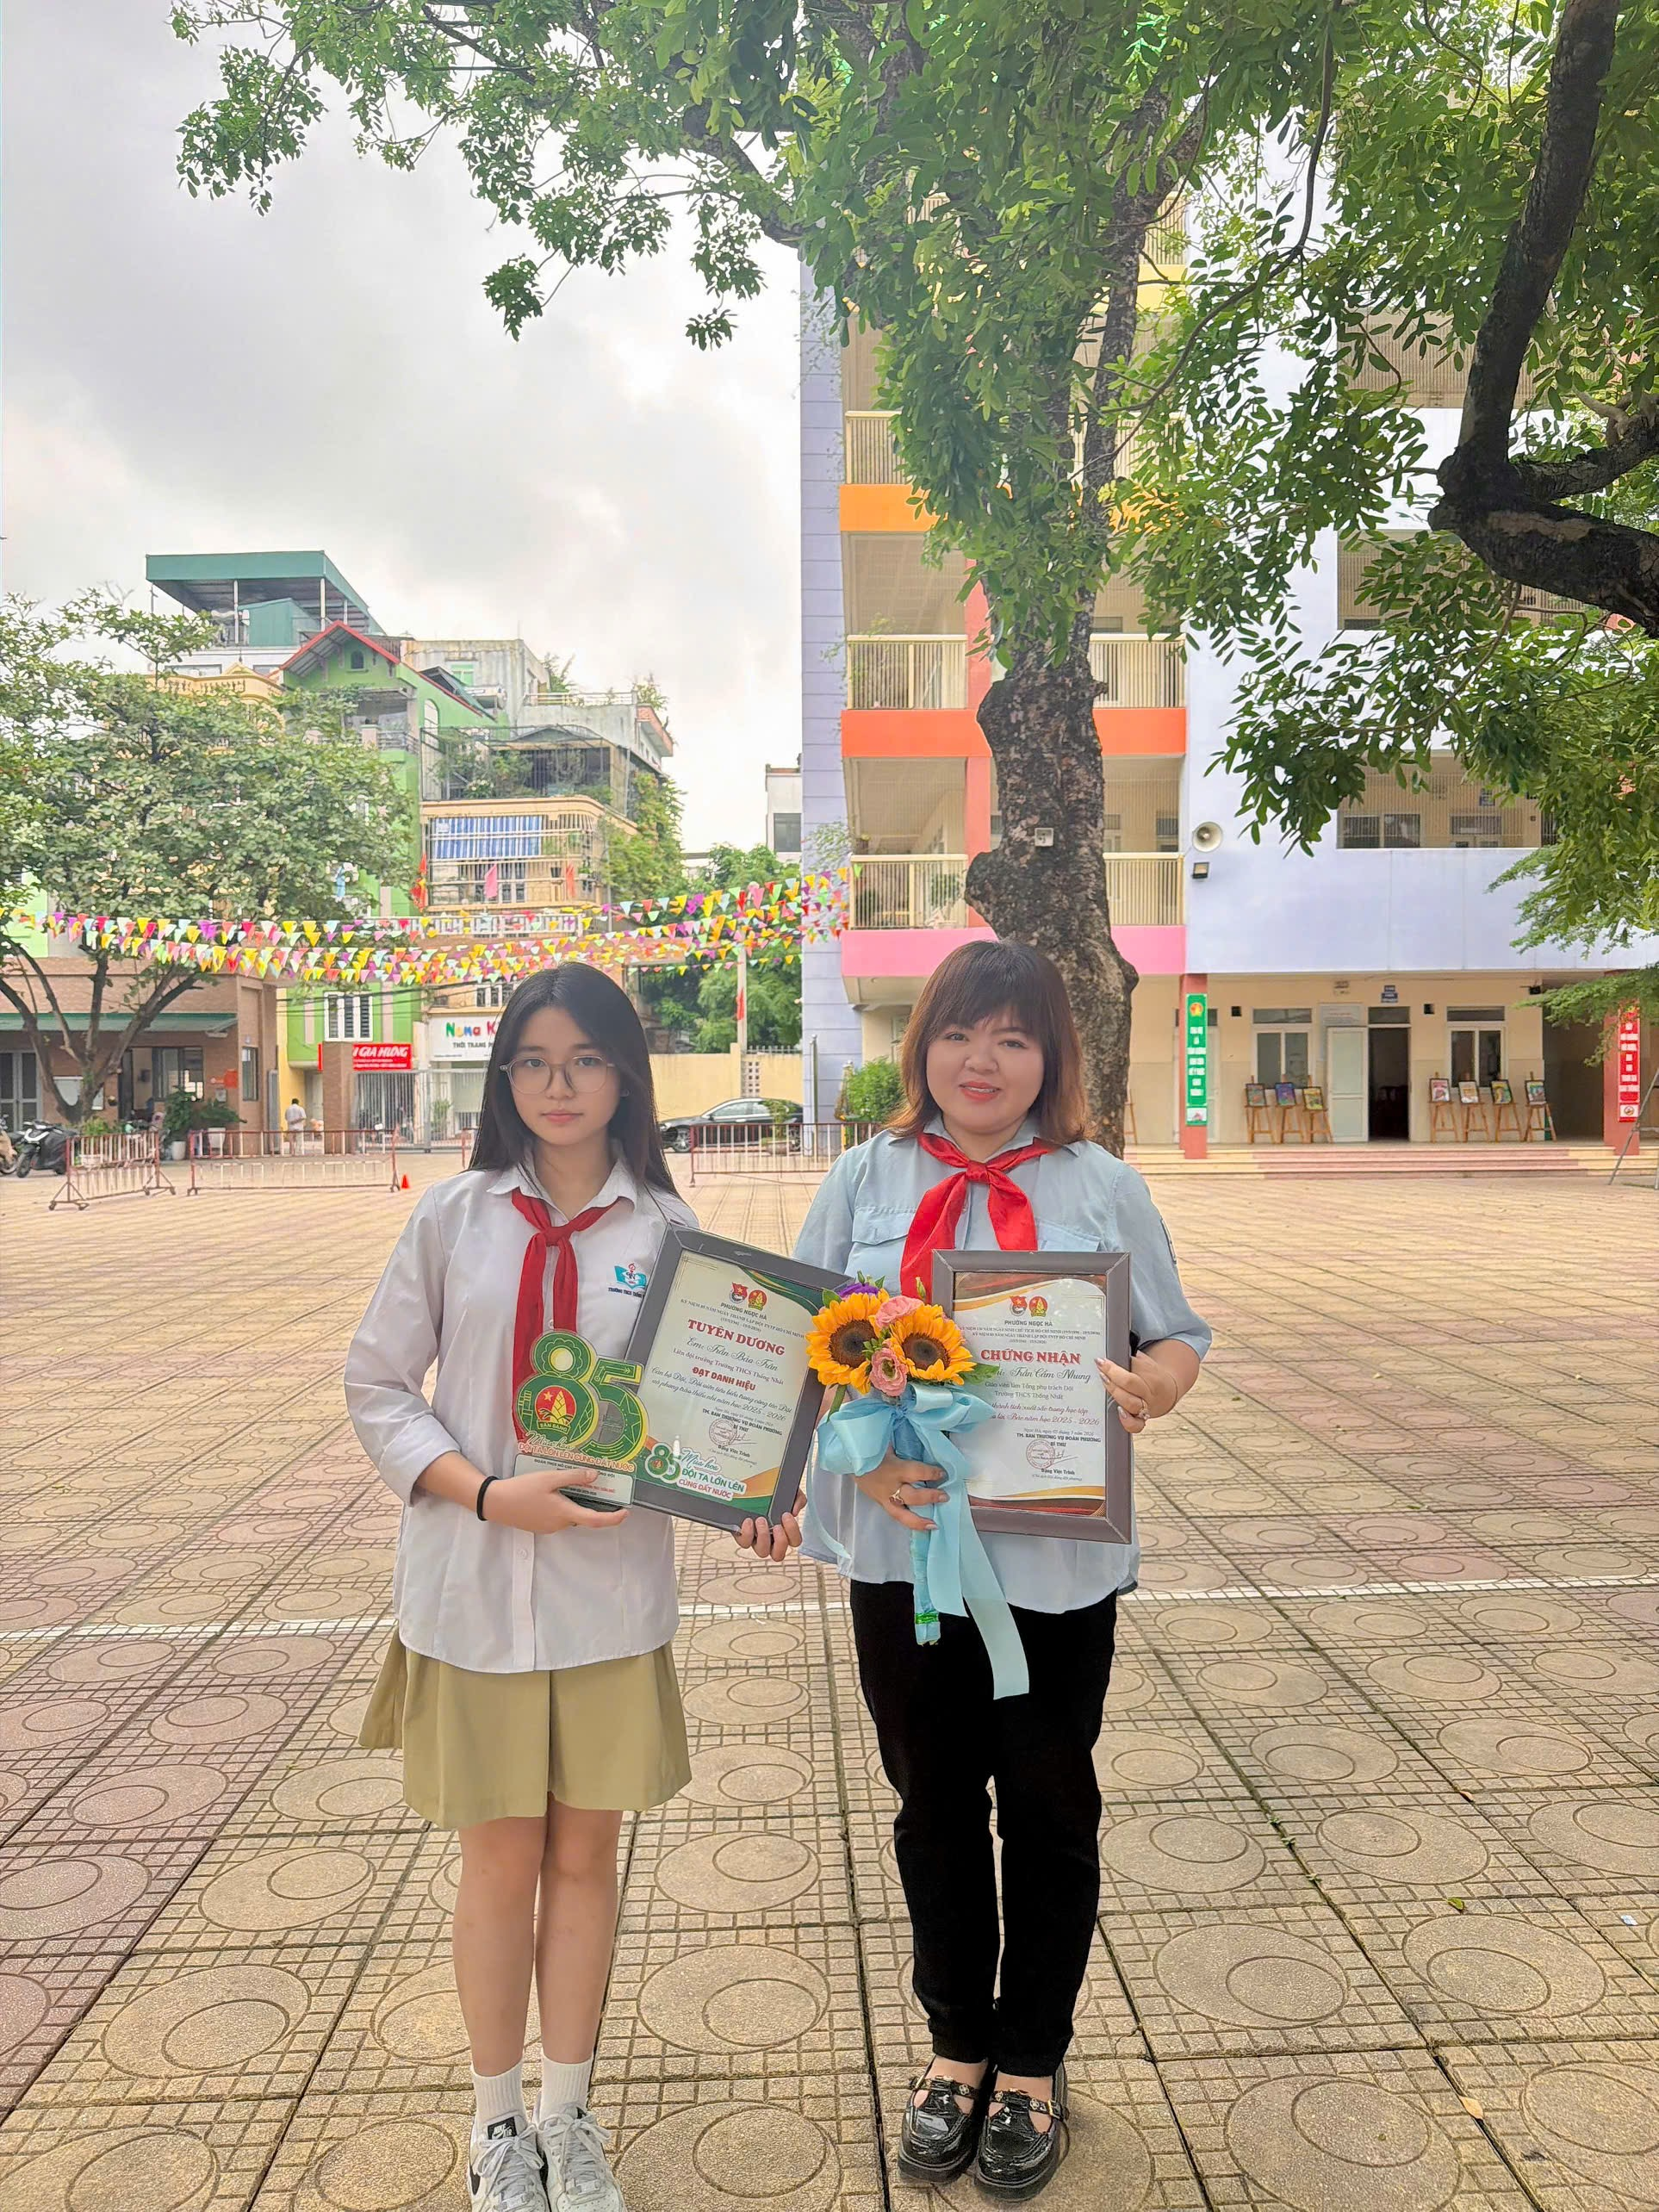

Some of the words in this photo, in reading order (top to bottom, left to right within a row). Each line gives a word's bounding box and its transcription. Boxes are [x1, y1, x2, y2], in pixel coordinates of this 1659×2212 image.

[721, 1302, 743, 1314] PHƯỜNG
[744, 1309, 758, 1318] NGỌC
[688, 1320, 734, 1340] TUYÊN
[736, 1333, 785, 1356] DƯƠNG
[980, 1349, 1034, 1362] CHỨNG
[1036, 1351, 1081, 1366] NHẬN
[693, 1366, 710, 1377] ĐẠT
[711, 1371, 734, 1385] DANH
[736, 1379, 756, 1391] HIỆU
[694, 1355, 713, 1366] trưởng
[715, 1360, 734, 1371] Trường
[736, 1366, 754, 1375] THCS
[753, 1370, 770, 1382] Thống
[771, 1376, 784, 1385] Nhất
[1057, 1369, 1090, 1383] Nhung
[743, 1404, 762, 1414] 2025
[767, 1411, 786, 1421] 2026
[519, 1442, 532, 1454] ĐỘI
[532, 1445, 544, 1454] TA
[679, 1478, 697, 1488] CÙNG
[698, 1483, 711, 1493] ĐẤT
[712, 1488, 732, 1499] NƯỚC
[682, 1469, 696, 1478] ĐỘI
[699, 1473, 708, 1482] TA
[711, 1476, 727, 1487] LỚN
[729, 1480, 744, 1492] LÊN
